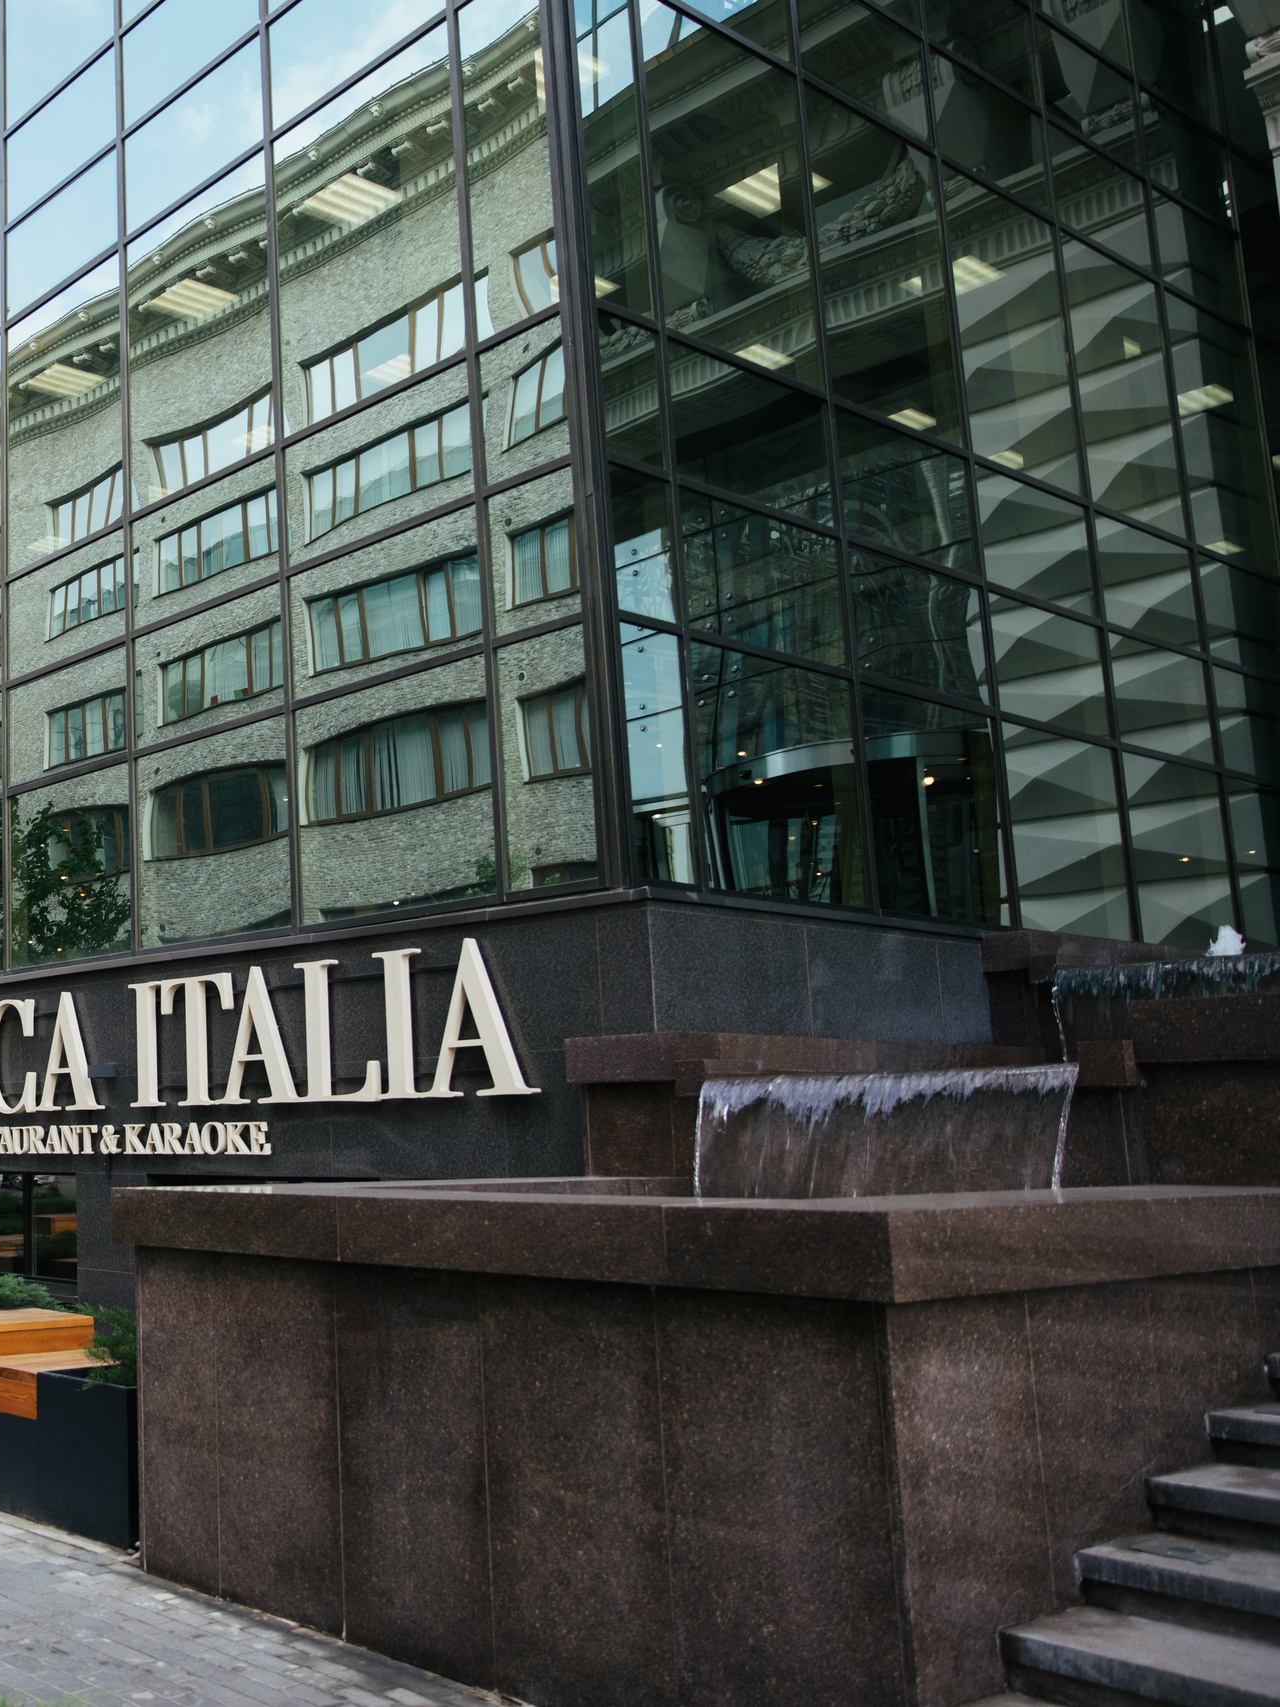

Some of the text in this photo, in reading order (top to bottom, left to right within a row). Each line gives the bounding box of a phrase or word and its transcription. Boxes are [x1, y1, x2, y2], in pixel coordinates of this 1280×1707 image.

[128, 937, 542, 1107] ITALIA
[99, 1124, 122, 1155] &
[122, 1121, 272, 1156] KARAOKE
